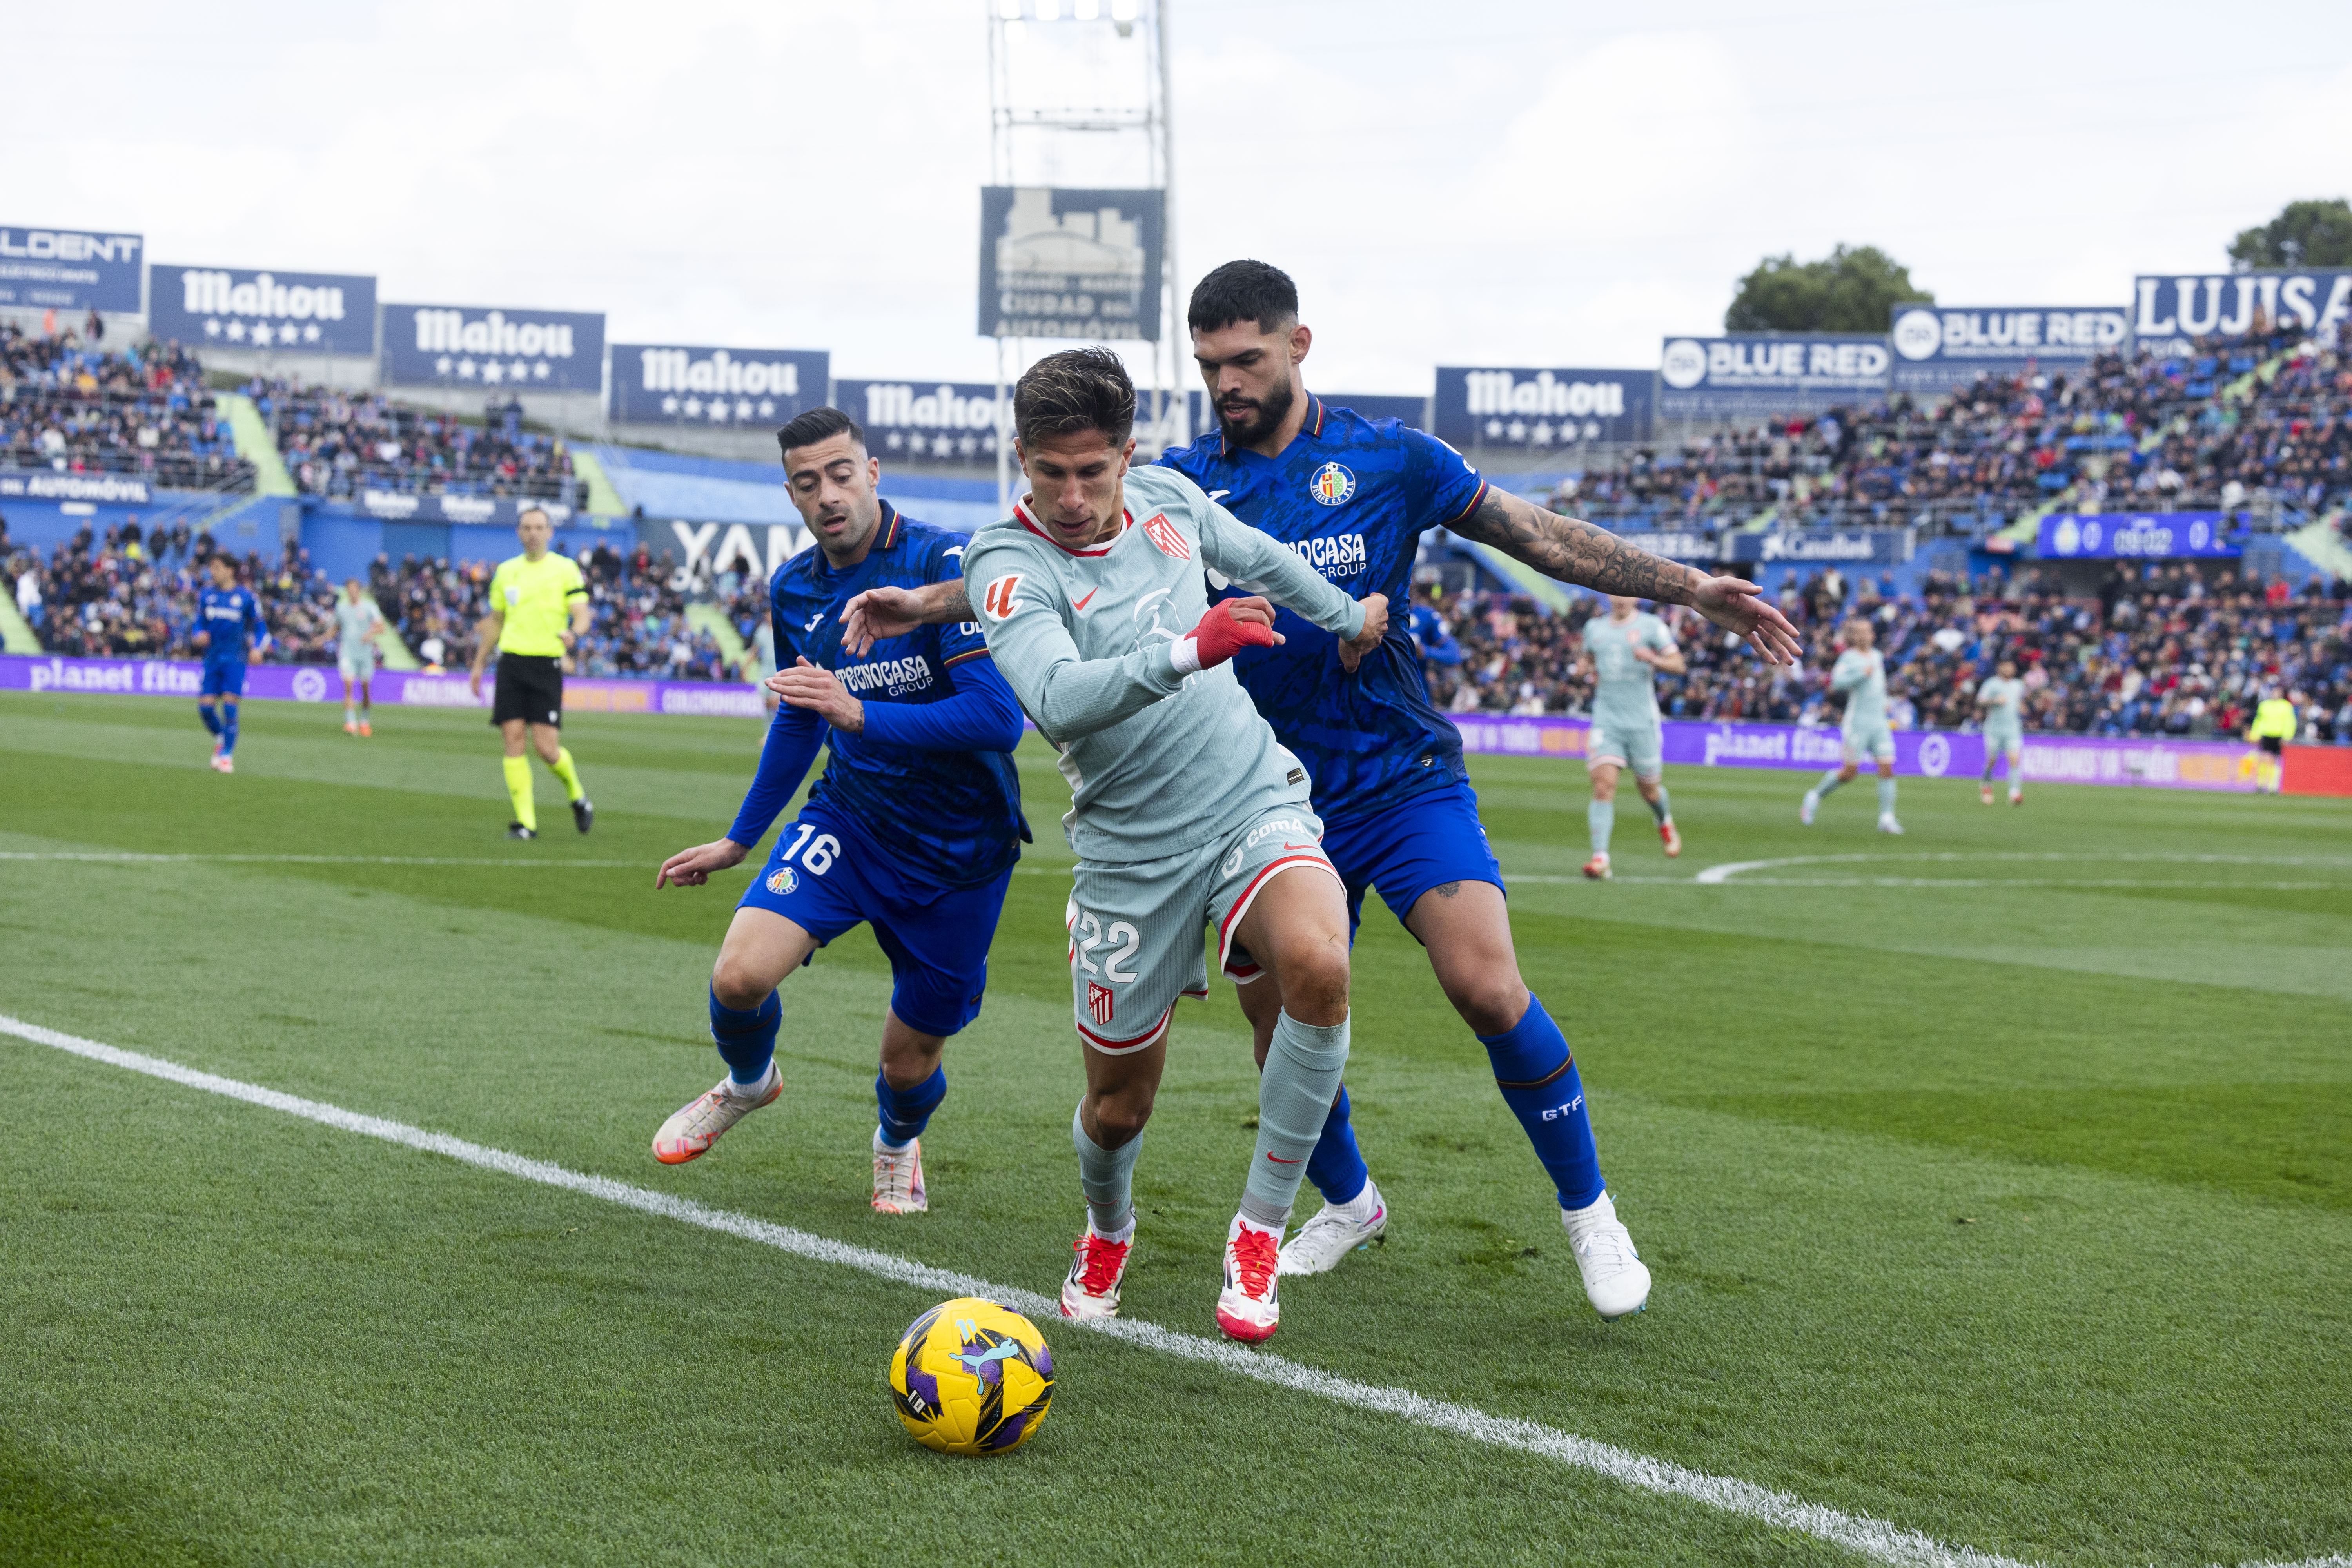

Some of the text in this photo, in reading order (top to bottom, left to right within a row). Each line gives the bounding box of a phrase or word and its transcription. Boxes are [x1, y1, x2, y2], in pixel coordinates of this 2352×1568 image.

[182, 268, 345, 320] Mahou
[1000, 294, 1095, 315] CIUDAD
[414, 309, 574, 358] Mahou
[1942, 313, 2039, 347] BLUE
[2045, 313, 2127, 347] RED
[641, 348, 798, 394] Mahou
[1707, 342, 1802, 375] BLUE
[1809, 343, 1889, 377] RED
[1465, 370, 1625, 417] Mahou
[1312, 485, 1329, 503] GETAFE
[1344, 481, 1354, 497] S.A.D.
[1282, 534, 1366, 566] OCASA
[1316, 563, 1367, 579] GROUP
[960, 621, 984, 635] OL
[29, 657, 134, 692] planet
[835, 655, 930, 692] TECNOCASA
[889, 677, 933, 696] GROUP
[1705, 724, 1842, 766] planet fitn
[782, 823, 841, 876] 16
[1078, 910, 1140, 984] 22
